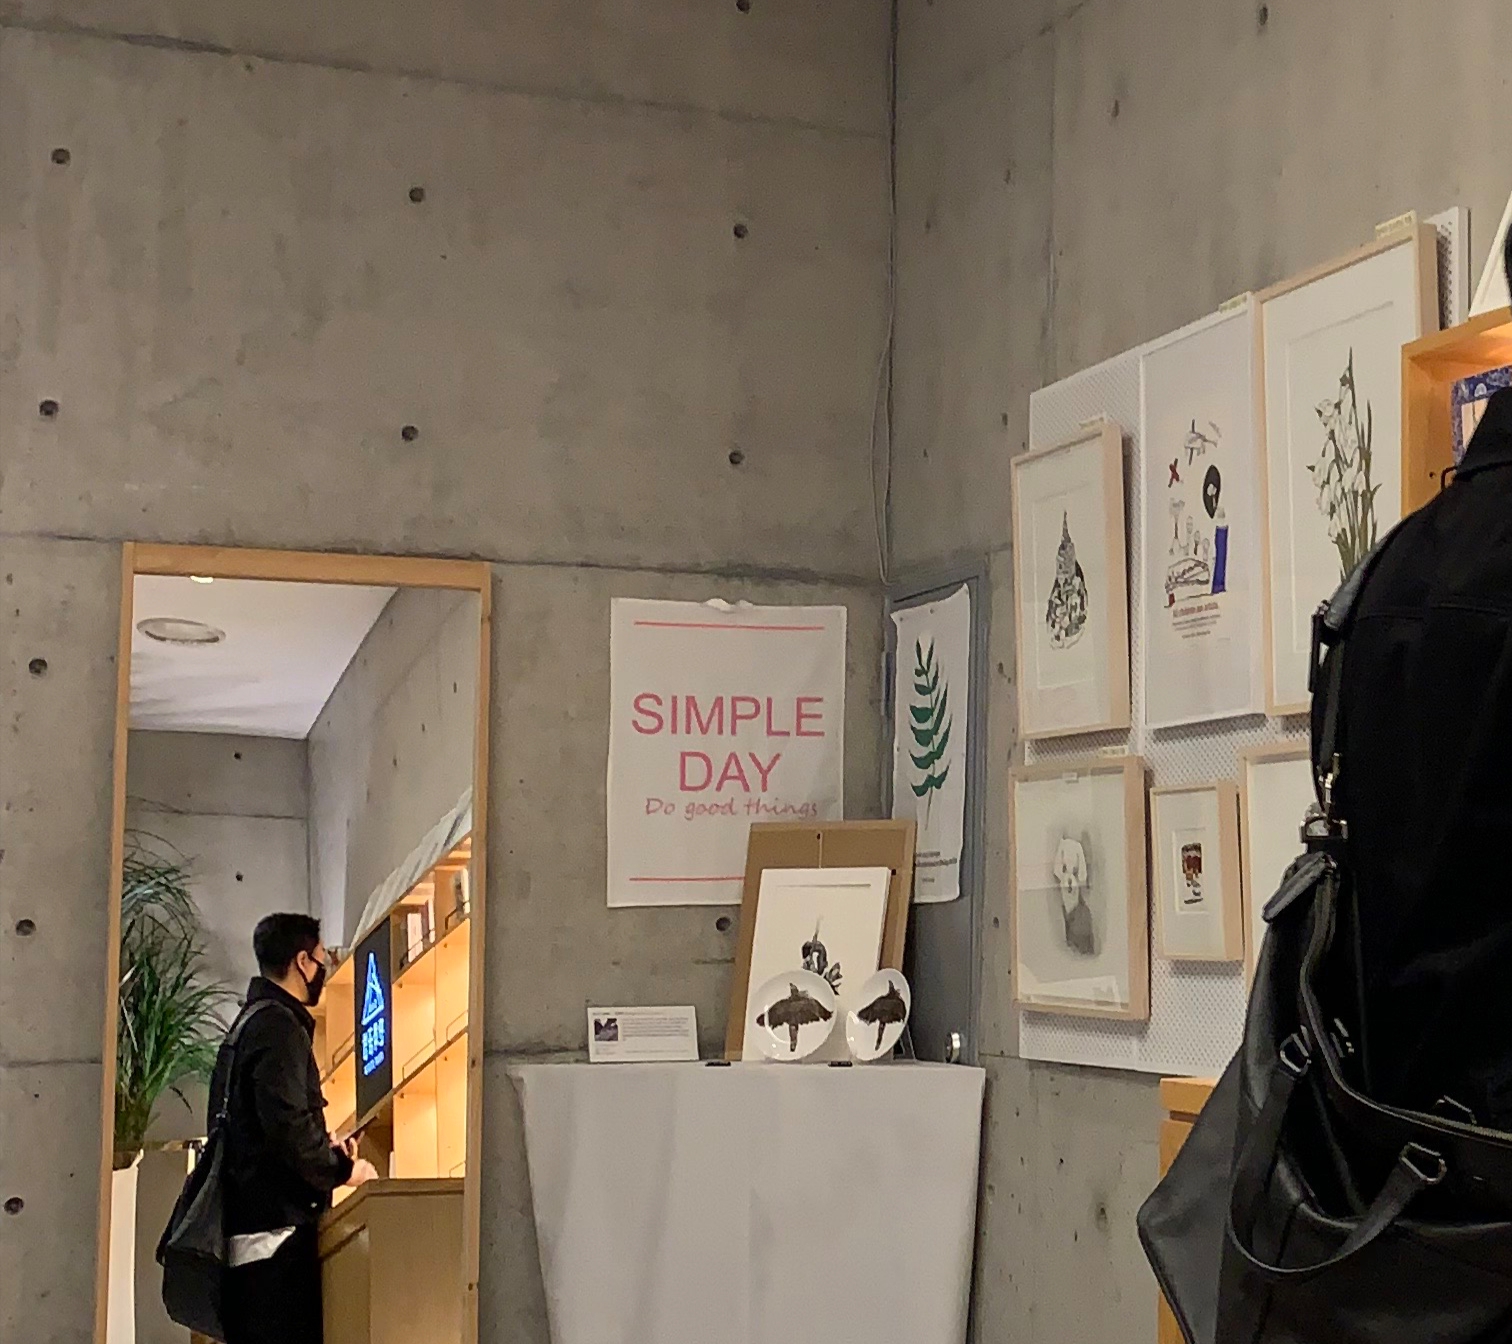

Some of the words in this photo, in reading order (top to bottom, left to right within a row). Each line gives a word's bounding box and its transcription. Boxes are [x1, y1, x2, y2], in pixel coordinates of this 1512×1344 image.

[630, 692, 826, 738] SIMPLE
[677, 750, 782, 794] DAY
[645, 797, 676, 816] Do
[684, 797, 736, 821] good
[744, 796, 818, 820] things
